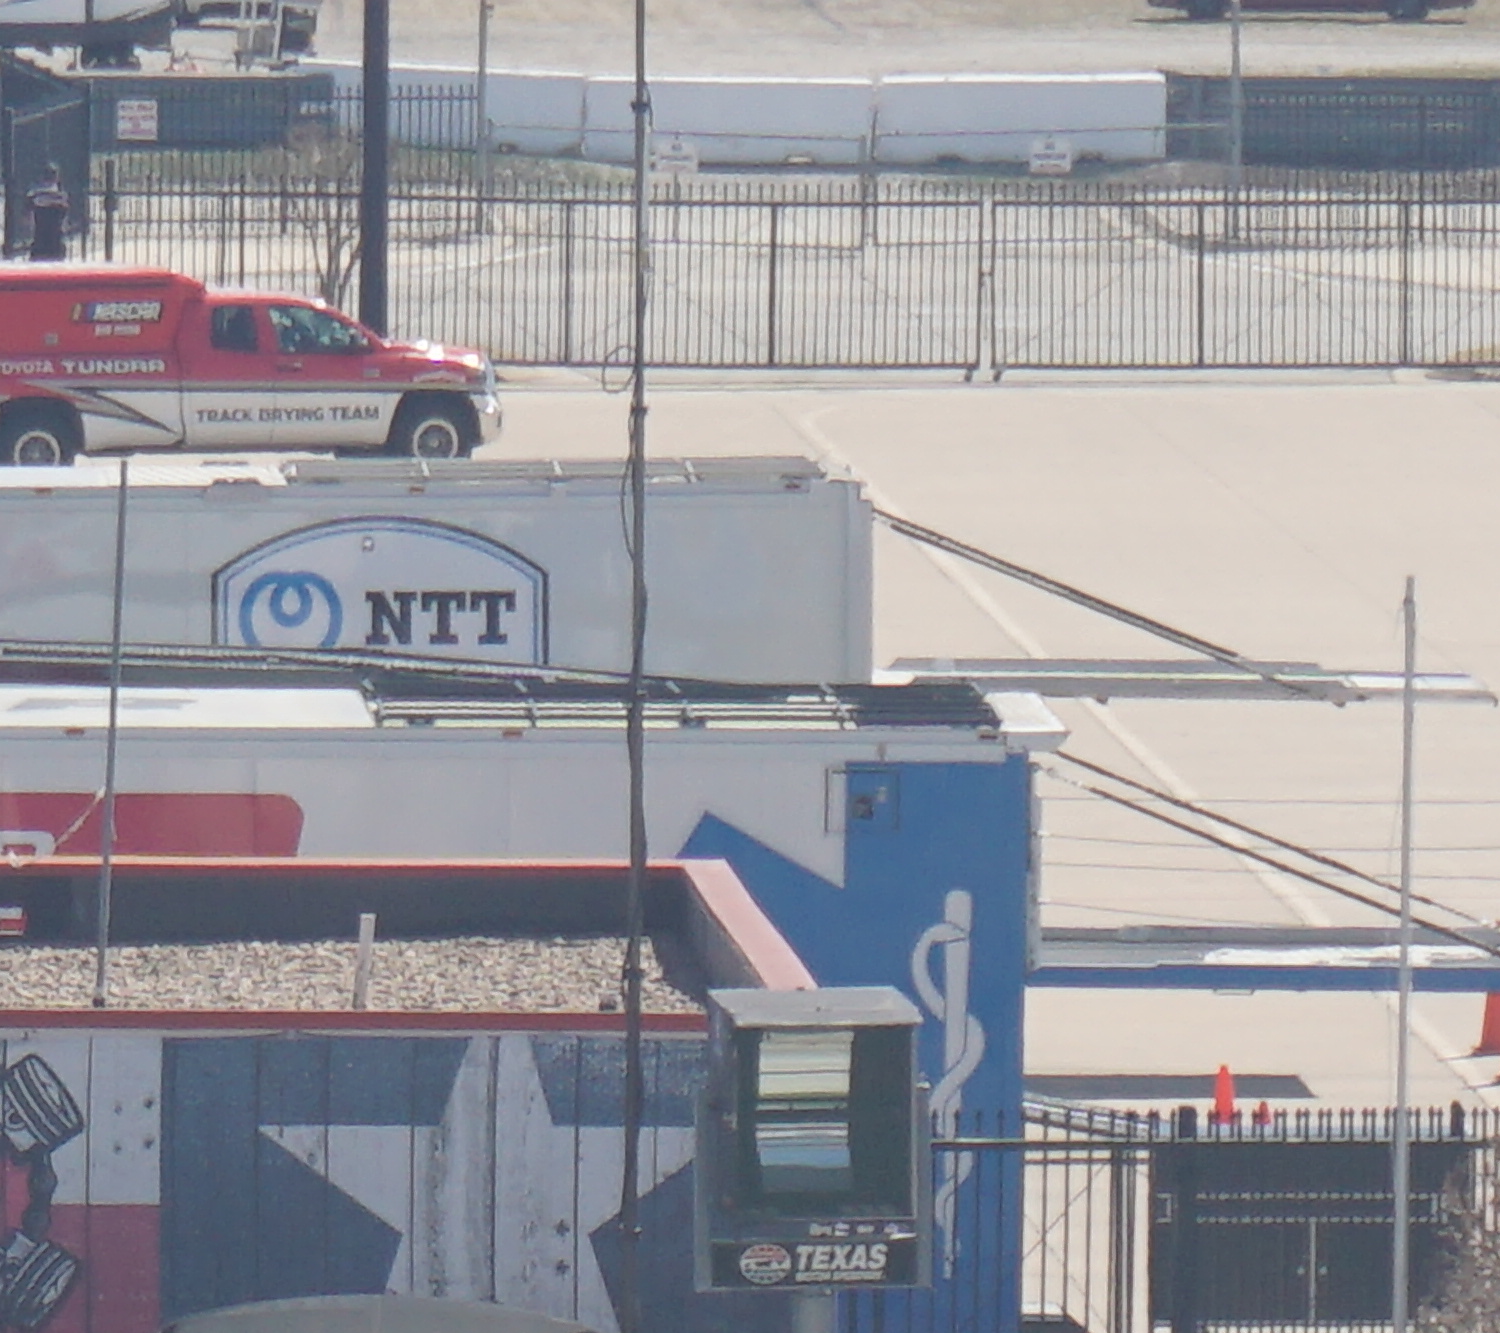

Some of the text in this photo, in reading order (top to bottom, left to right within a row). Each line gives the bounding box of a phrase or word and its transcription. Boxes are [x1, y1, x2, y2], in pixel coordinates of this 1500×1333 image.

[61, 359, 166, 375] TUNDRA
[197, 407, 380, 423] TRACK DRYING TEAM
[365, 590, 518, 648] NTT
[796, 1243, 888, 1270] TEXAS
